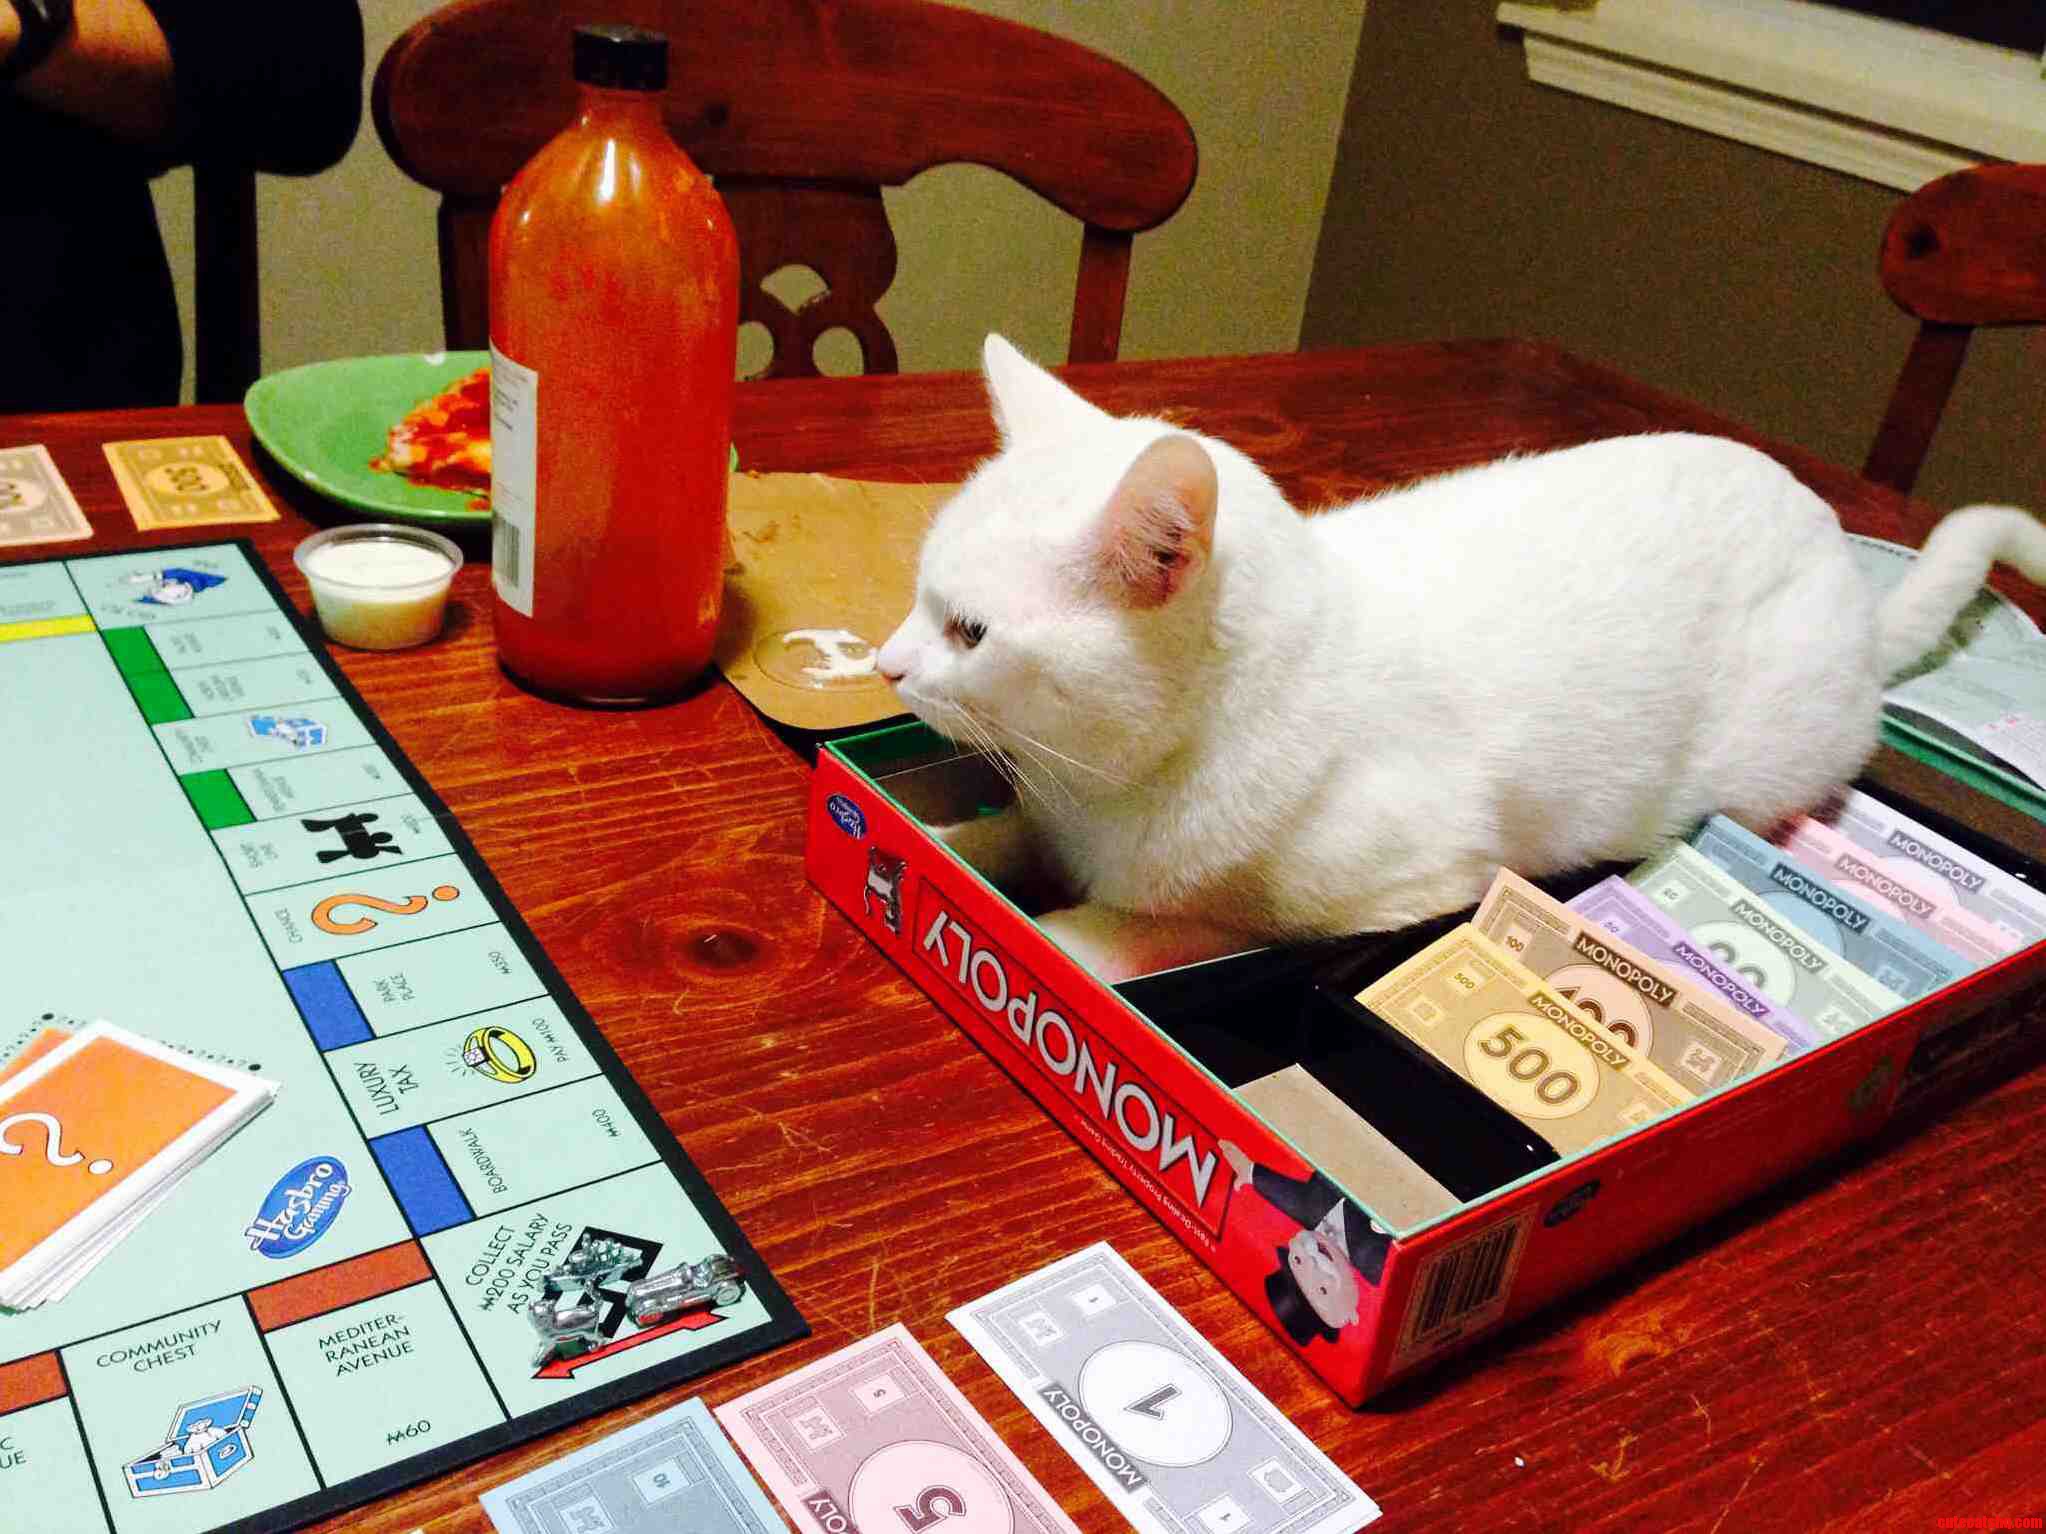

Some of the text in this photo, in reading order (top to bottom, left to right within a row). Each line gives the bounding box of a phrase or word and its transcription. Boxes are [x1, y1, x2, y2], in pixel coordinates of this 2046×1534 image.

[1838, 857, 1933, 916] MONOPOLY
[1890, 832, 1983, 891] MONOPOLY
[273, 906, 303, 945] CHANCE
[1773, 866, 1869, 930] MONOPOLY
[1734, 902, 1825, 971] MONOPOLY
[1576, 937, 1675, 1005] MONOPOLY
[1674, 944, 1766, 1015] MONOPOLY
[548, 1040, 570, 1065] PAY
[922, 909, 1218, 1209] MONOPOLY
[1532, 996, 1628, 1067] MONOPOLY
[354, 1062, 400, 1117] LUXURY
[390, 1063, 420, 1096] TAX
[1478, 1023, 1581, 1105] 500
[458, 1126, 508, 1195] BOARDWALK
[244, 1162, 334, 1251] Hasbro
[465, 1224, 516, 1287] COLLECT
[507, 1222, 574, 1315] AS YOU PASS
[511, 1213, 550, 1268] SALARY
[96, 1319, 222, 1368] COMMUNITY
[133, 1345, 198, 1373] CHEST
[325, 1326, 411, 1363] RANEAN
[336, 1342, 415, 1377] AVENUE
[1042, 1386, 1144, 1489] MONOPOLY
[653, 1473, 671, 1488] 10
[893, 1484, 967, 1534] 5
